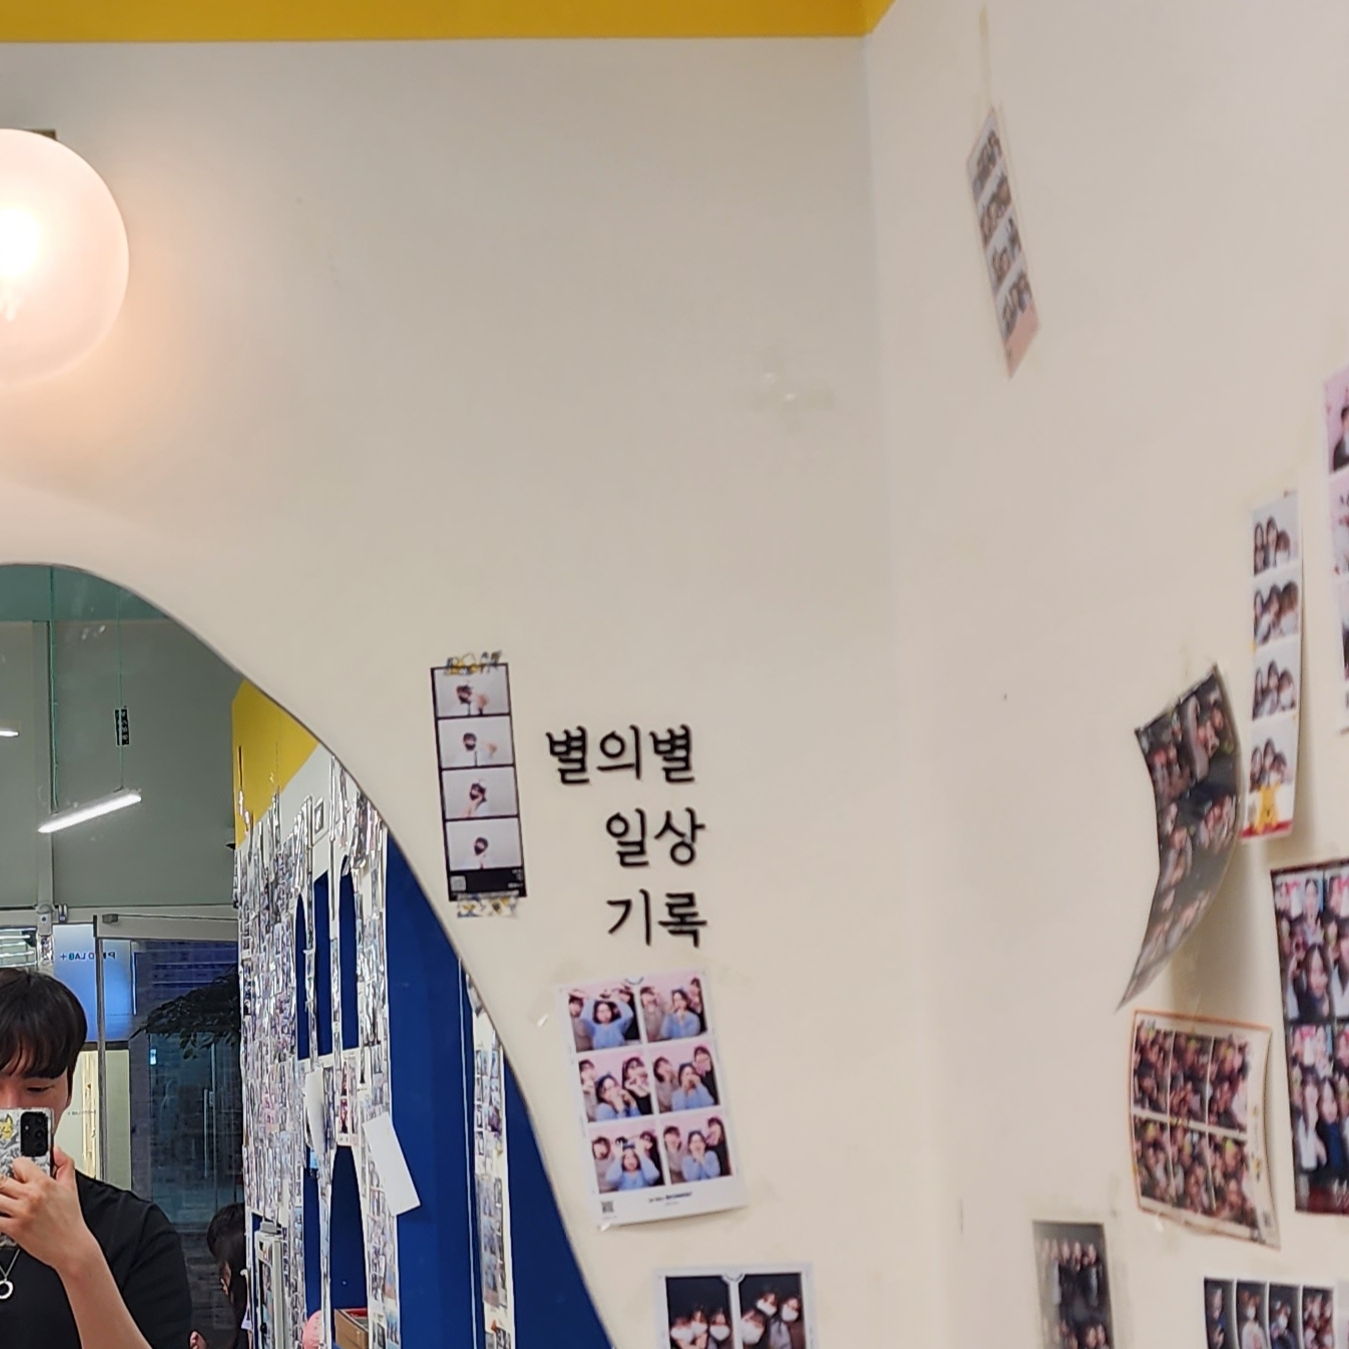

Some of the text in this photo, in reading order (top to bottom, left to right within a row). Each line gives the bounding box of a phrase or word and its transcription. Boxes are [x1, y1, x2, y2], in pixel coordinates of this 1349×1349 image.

[545, 724, 695, 785] 별의별
[606, 807, 706, 867] 일상
[606, 888, 707, 947] 기록
